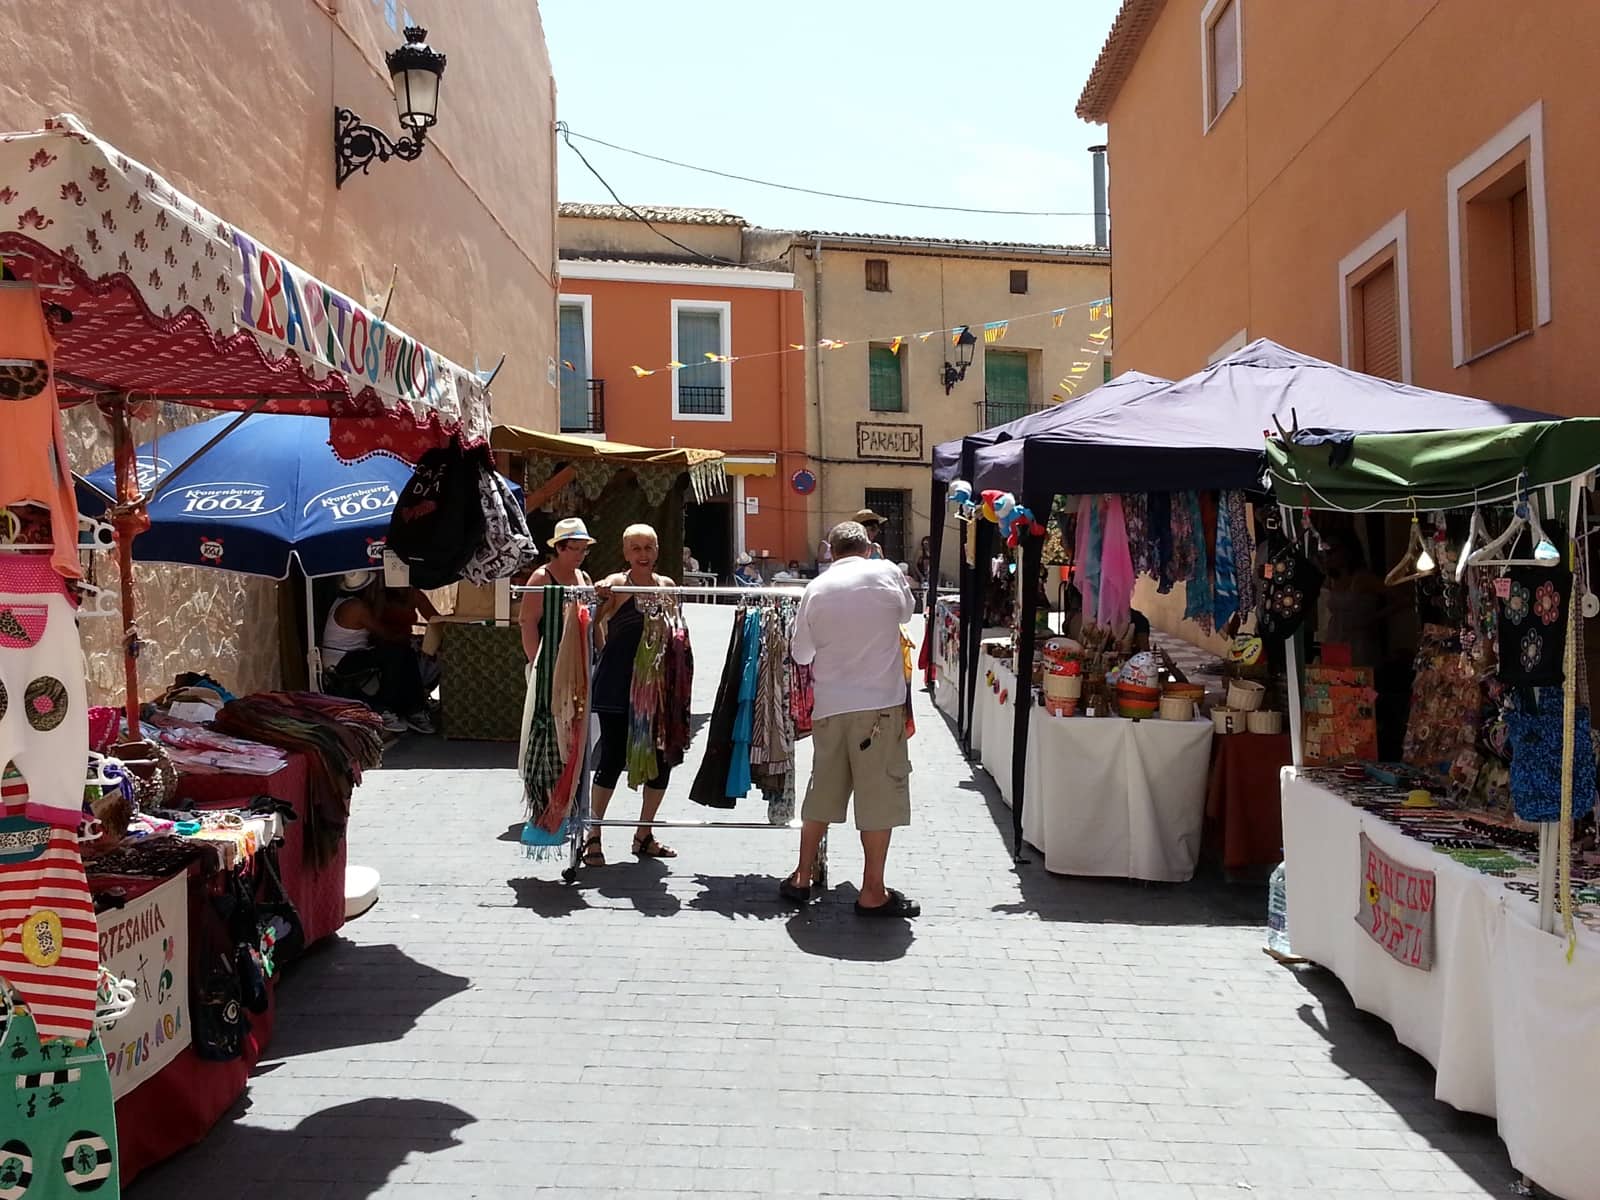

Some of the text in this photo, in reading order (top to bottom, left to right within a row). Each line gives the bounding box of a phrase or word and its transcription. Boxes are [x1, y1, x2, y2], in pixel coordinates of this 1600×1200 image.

[183, 494, 266, 513] 1664
[184, 488, 265, 498] Kronenbourg
[321, 484, 391, 508] Kronenbourg
[330, 490, 400, 521] 1664
[97, 901, 166, 965] RTESANÍA
